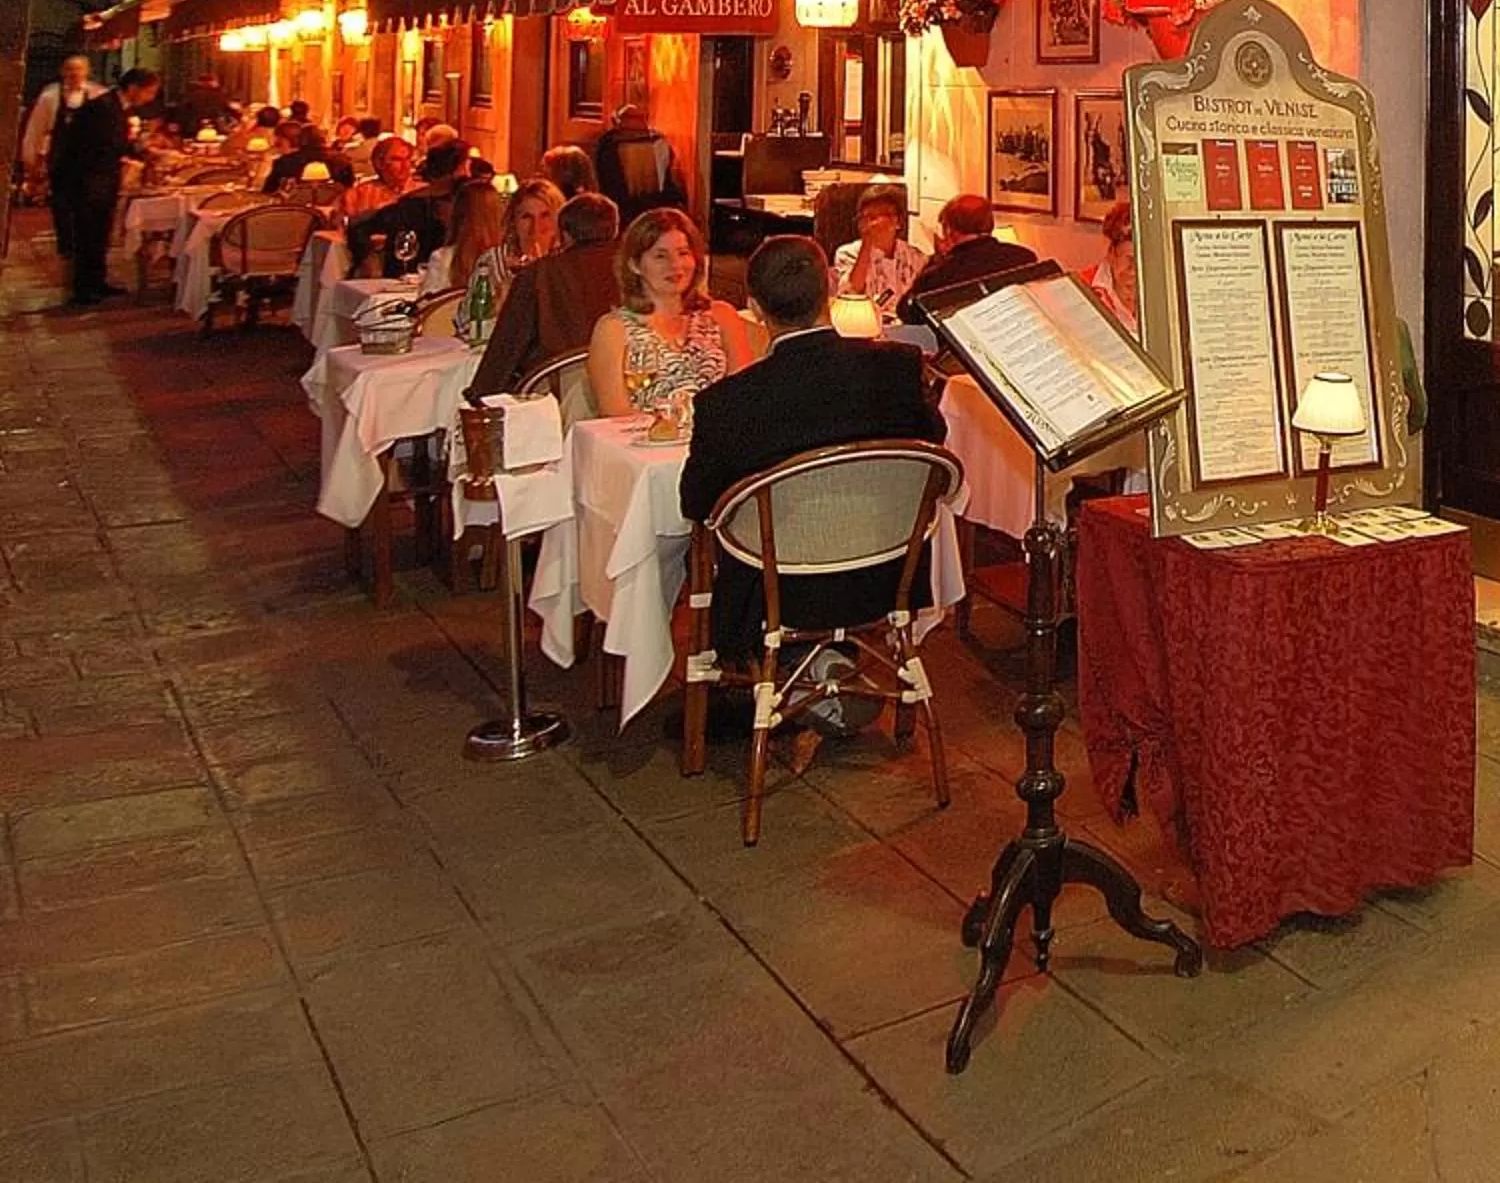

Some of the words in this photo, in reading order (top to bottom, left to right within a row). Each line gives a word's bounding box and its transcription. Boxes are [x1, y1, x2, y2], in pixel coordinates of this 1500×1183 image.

[1193, 95, 1251, 114] BISTROT
[1264, 99, 1319, 118] VENISE
[1166, 116, 1207, 131] Cucina
[1209, 119, 1250, 134] storica
[1252, 126, 1259, 135] e
[1260, 122, 1304, 137] classica
